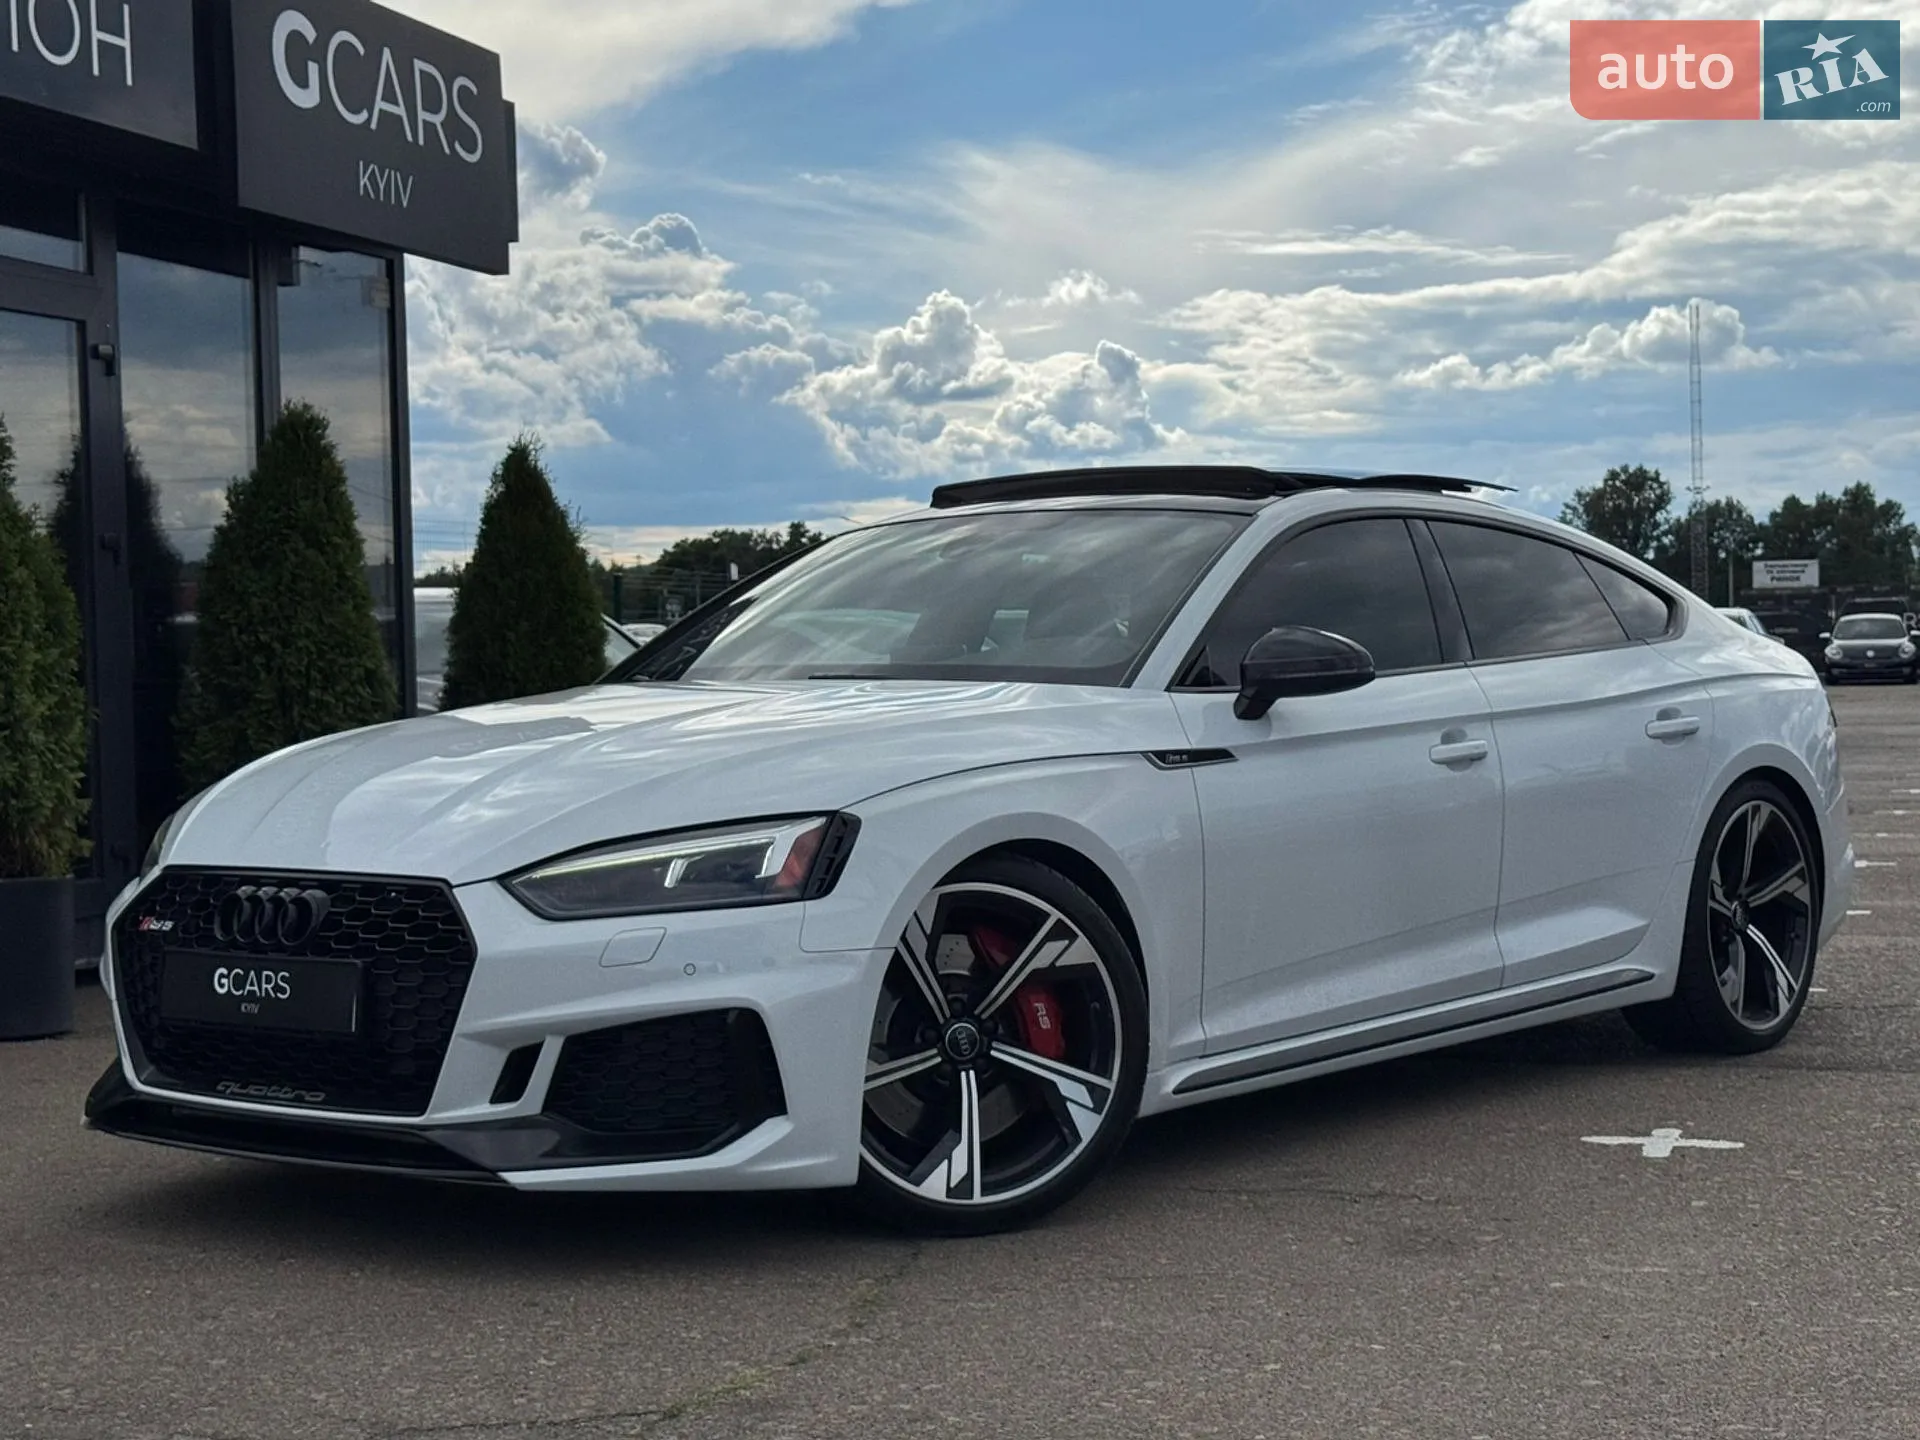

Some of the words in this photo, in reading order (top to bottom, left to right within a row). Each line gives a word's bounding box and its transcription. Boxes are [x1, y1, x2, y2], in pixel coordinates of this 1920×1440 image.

[271, 9, 484, 164] GCARS
[358, 160, 413, 208] KYIV
[213, 967, 291, 1000] GCARS
[1033, 1002, 1051, 1029] RS
[215, 1079, 326, 1102] quattro
